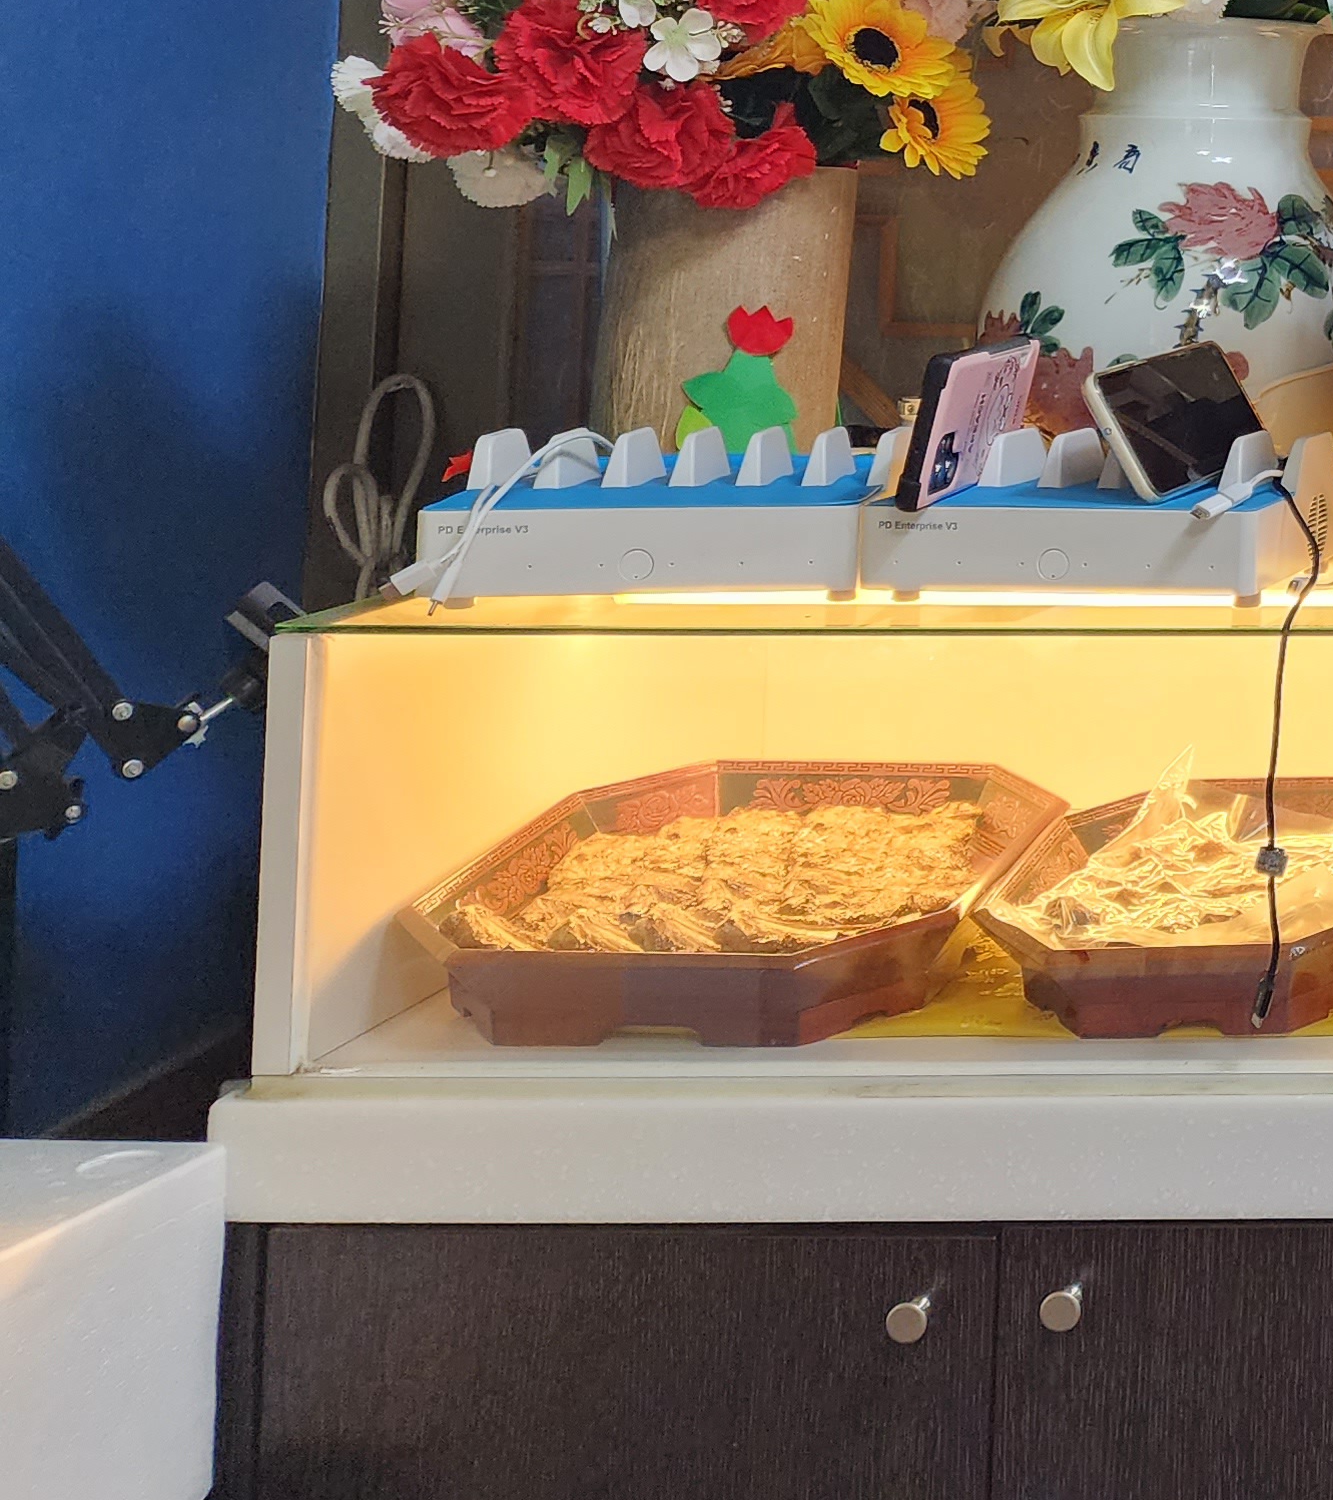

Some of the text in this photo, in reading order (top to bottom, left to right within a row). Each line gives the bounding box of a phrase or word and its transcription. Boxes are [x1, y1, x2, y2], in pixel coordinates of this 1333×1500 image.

[438, 525, 529, 535] PD Erprise V3
[879, 521, 958, 531] PD Enterprise V3
